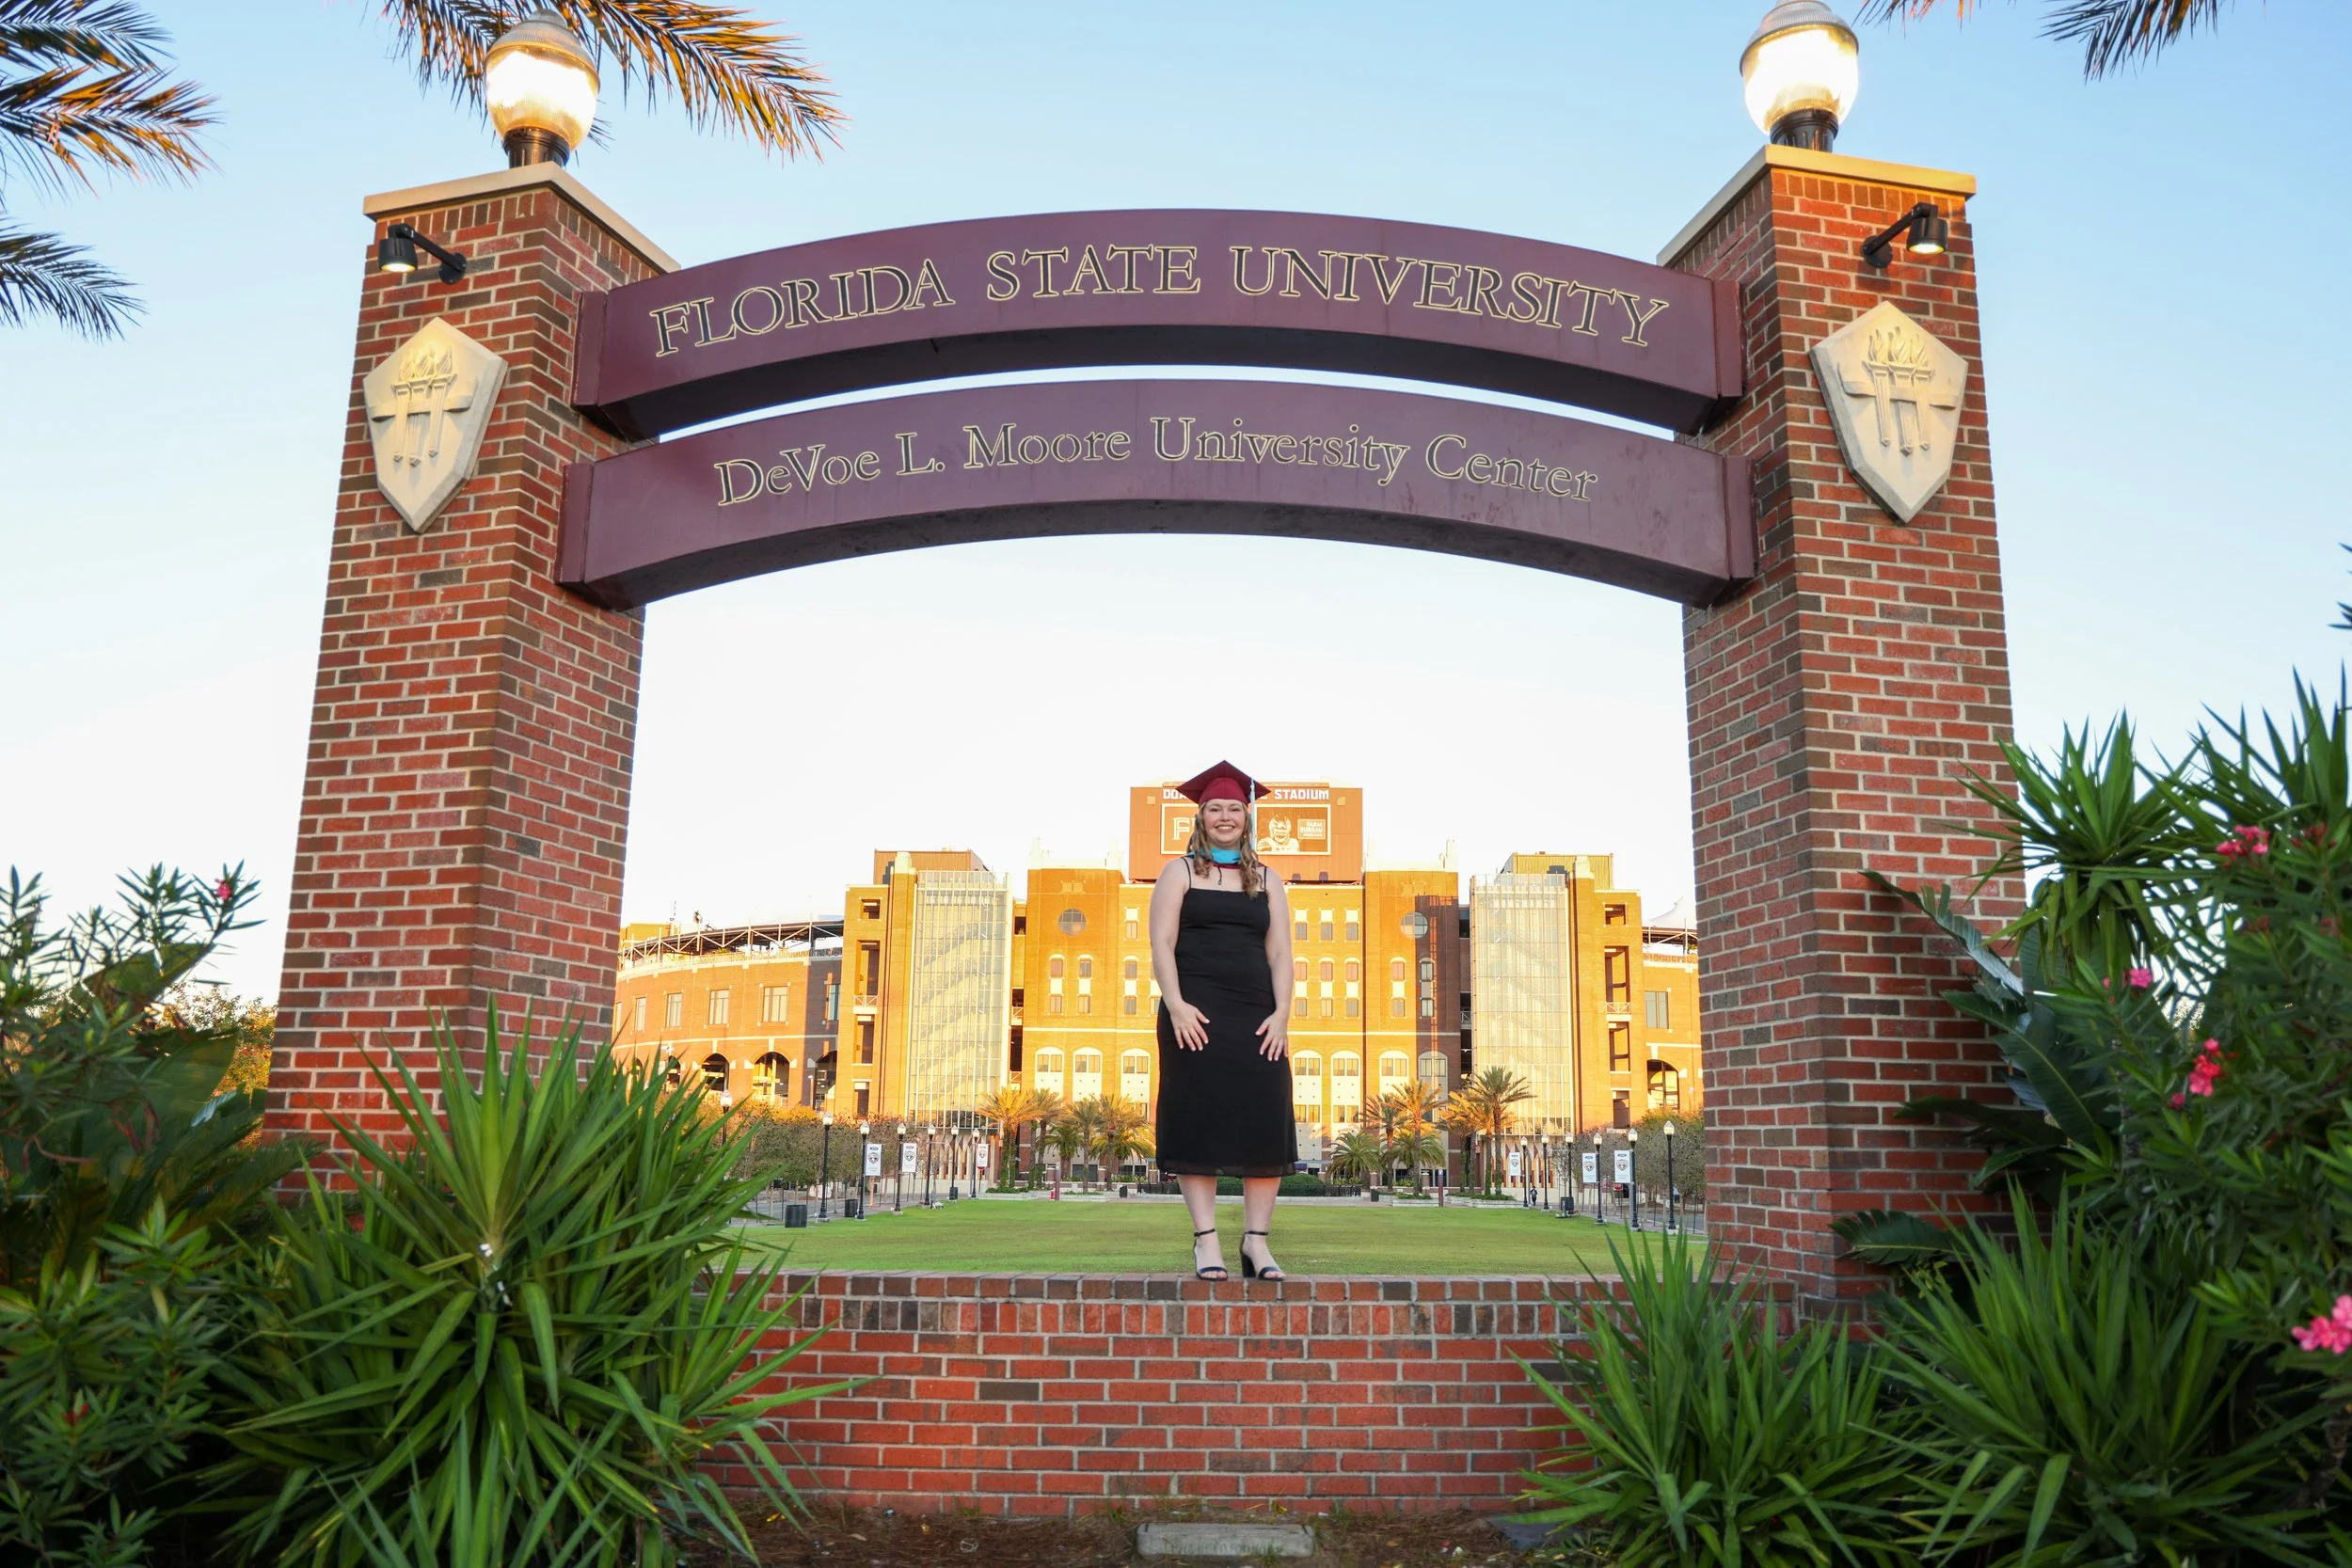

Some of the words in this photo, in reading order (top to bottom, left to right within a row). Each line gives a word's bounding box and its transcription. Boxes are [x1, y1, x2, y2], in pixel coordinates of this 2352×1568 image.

[649, 258, 956, 358] FLORIDA
[986, 244, 1201, 302] STATE
[1229, 245, 1670, 347] UNIVERSITY
[714, 443, 880, 506] DeVoe
[895, 431, 946, 476] L.
[962, 422, 1131, 469] Moore
[1150, 416, 1411, 486] University
[1424, 434, 1597, 502] Center
[1274, 788, 1330, 800] STADIUM
